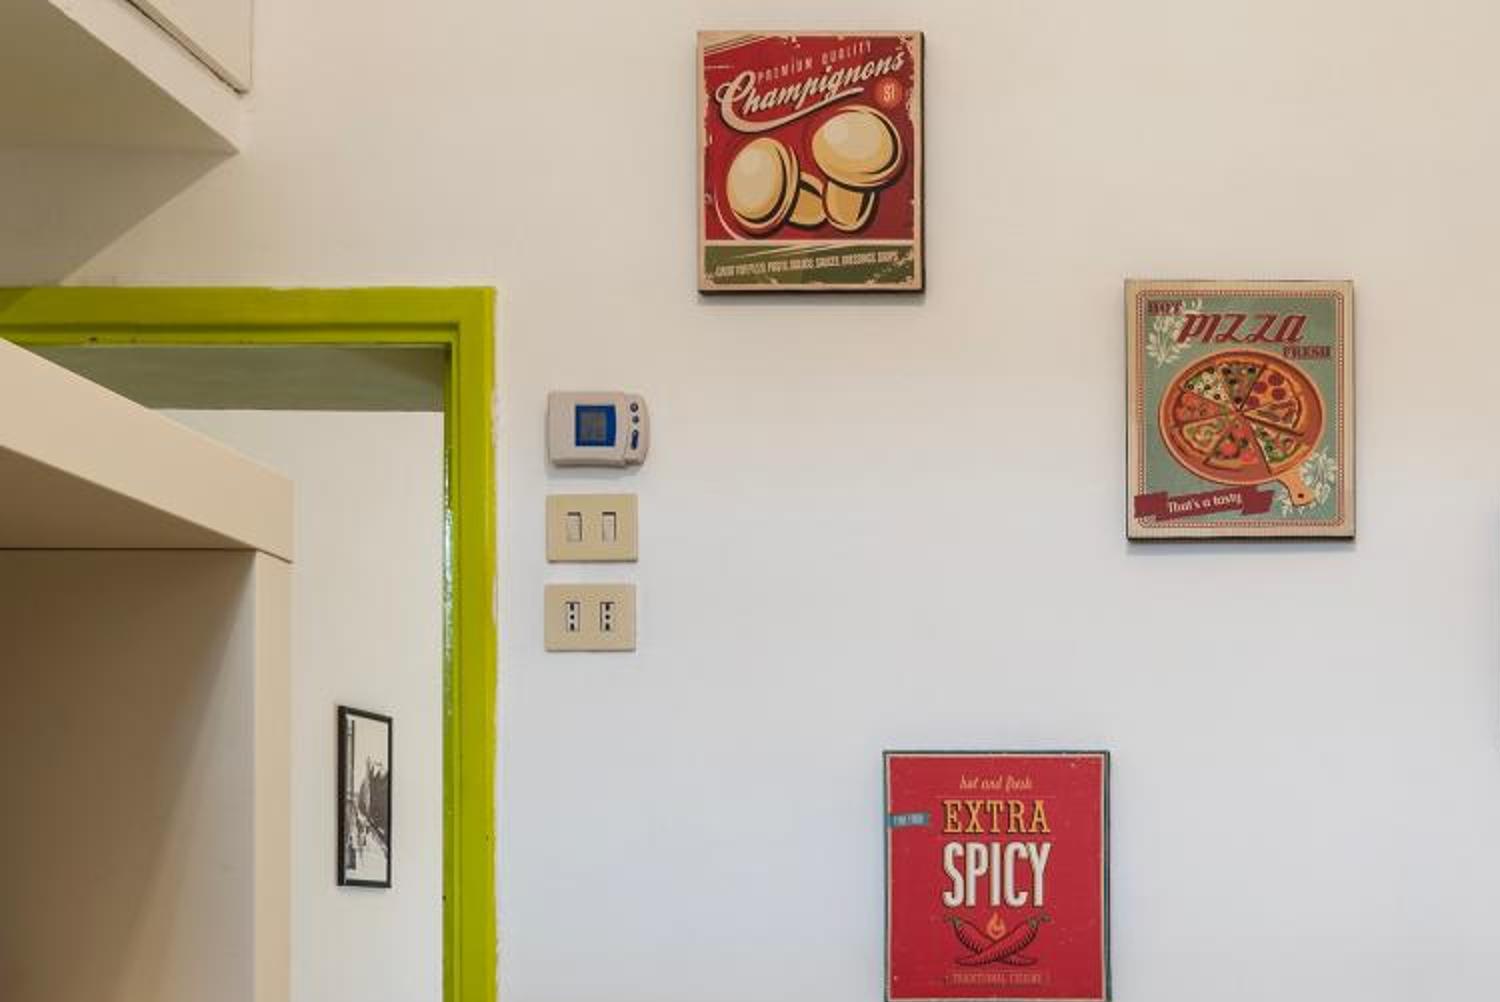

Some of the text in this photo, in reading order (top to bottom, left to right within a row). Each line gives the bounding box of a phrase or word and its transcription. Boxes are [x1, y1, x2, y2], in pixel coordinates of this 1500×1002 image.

[757, 40, 871, 84] PREMIUM QUALITY
[716, 51, 905, 132] Champignons
[943, 800, 1052, 833] EXTRA
[943, 842, 1052, 908] SPICY
